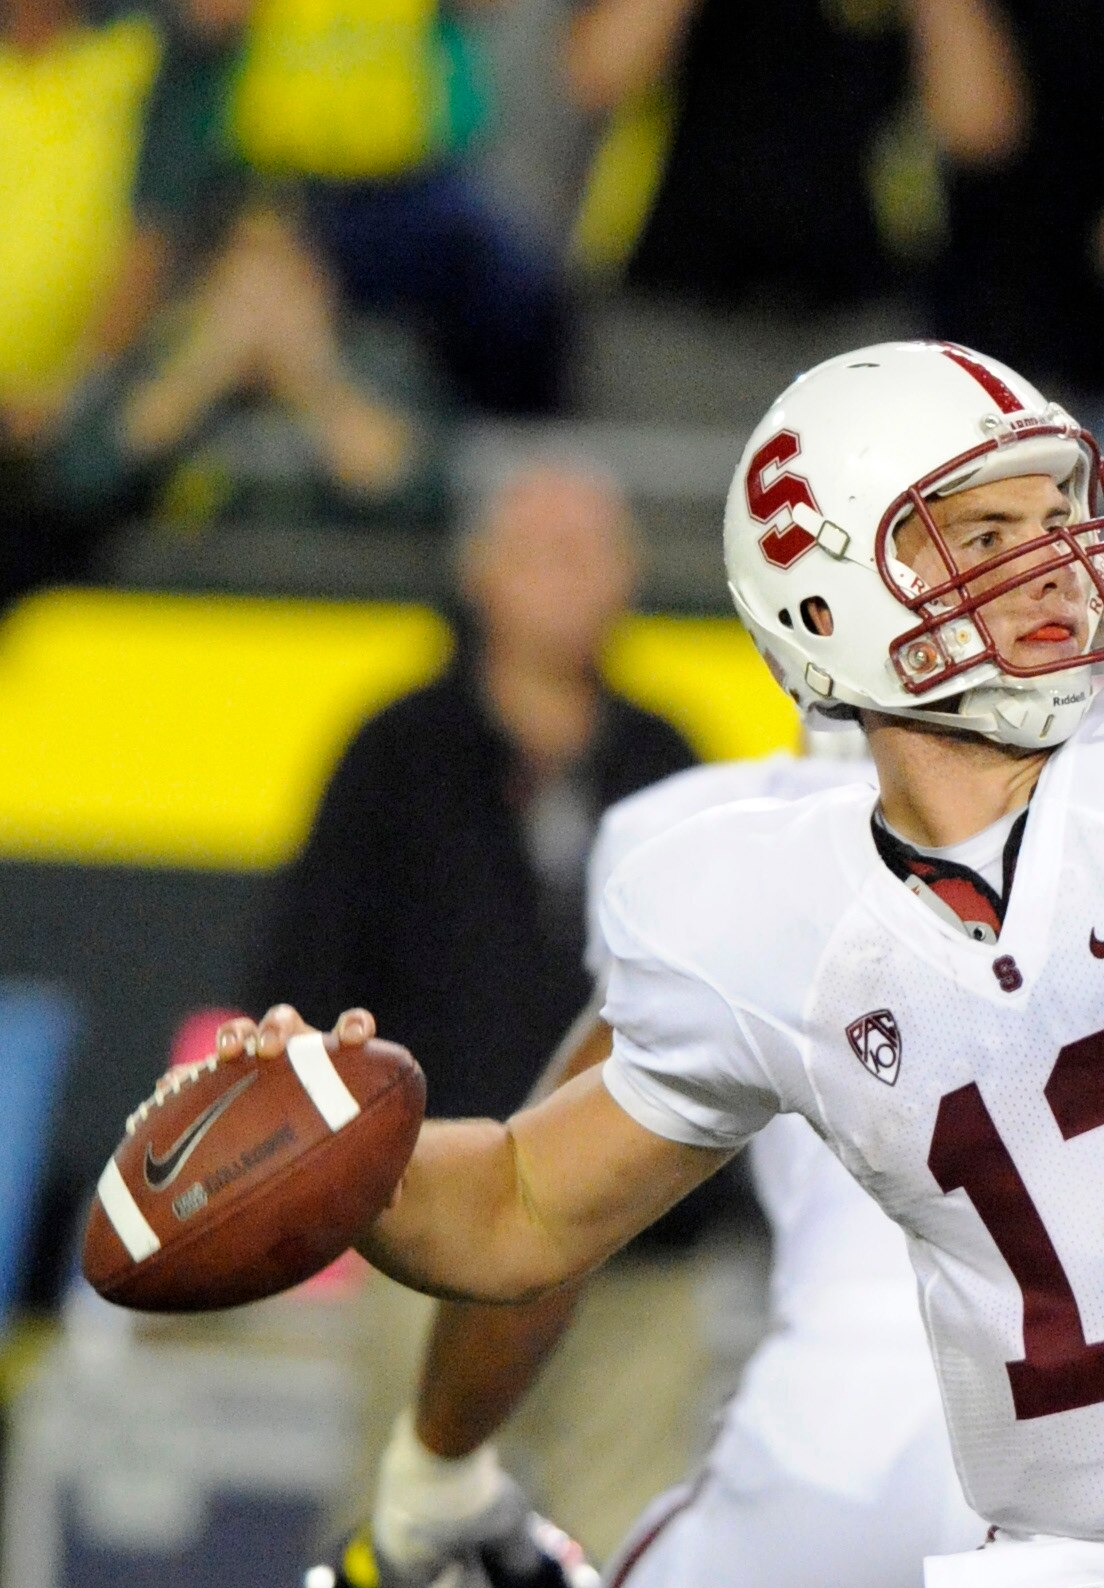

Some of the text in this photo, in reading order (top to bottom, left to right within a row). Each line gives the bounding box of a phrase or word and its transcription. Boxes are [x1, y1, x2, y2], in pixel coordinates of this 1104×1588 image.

[744, 428, 823, 570] S
[992, 954, 1023, 993] S
[848, 1011, 898, 1063] PAC
[868, 1043, 897, 1074] 10
